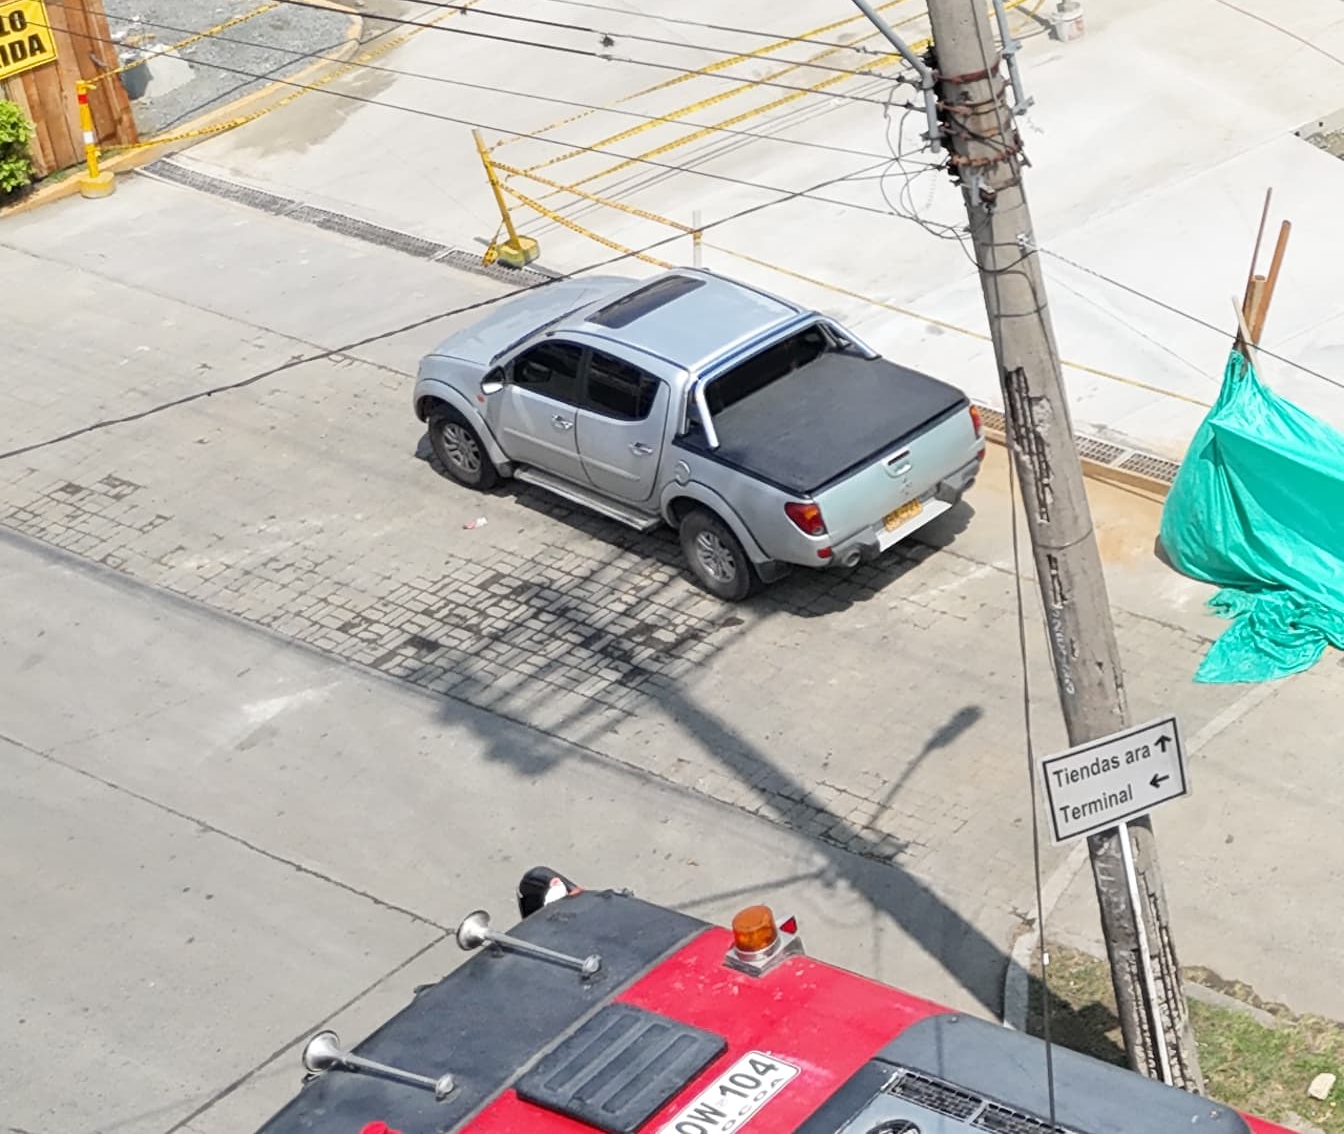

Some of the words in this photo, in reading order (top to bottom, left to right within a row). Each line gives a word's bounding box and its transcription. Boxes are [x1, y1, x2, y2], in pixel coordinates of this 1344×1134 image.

[0, 33, 48, 68] IDA
[1052, 757, 1121, 788] Tiendas
[1125, 744, 1151, 765] ara
[1059, 783, 1134, 824] Terminal
[719, 1058, 780, 1099] 104
